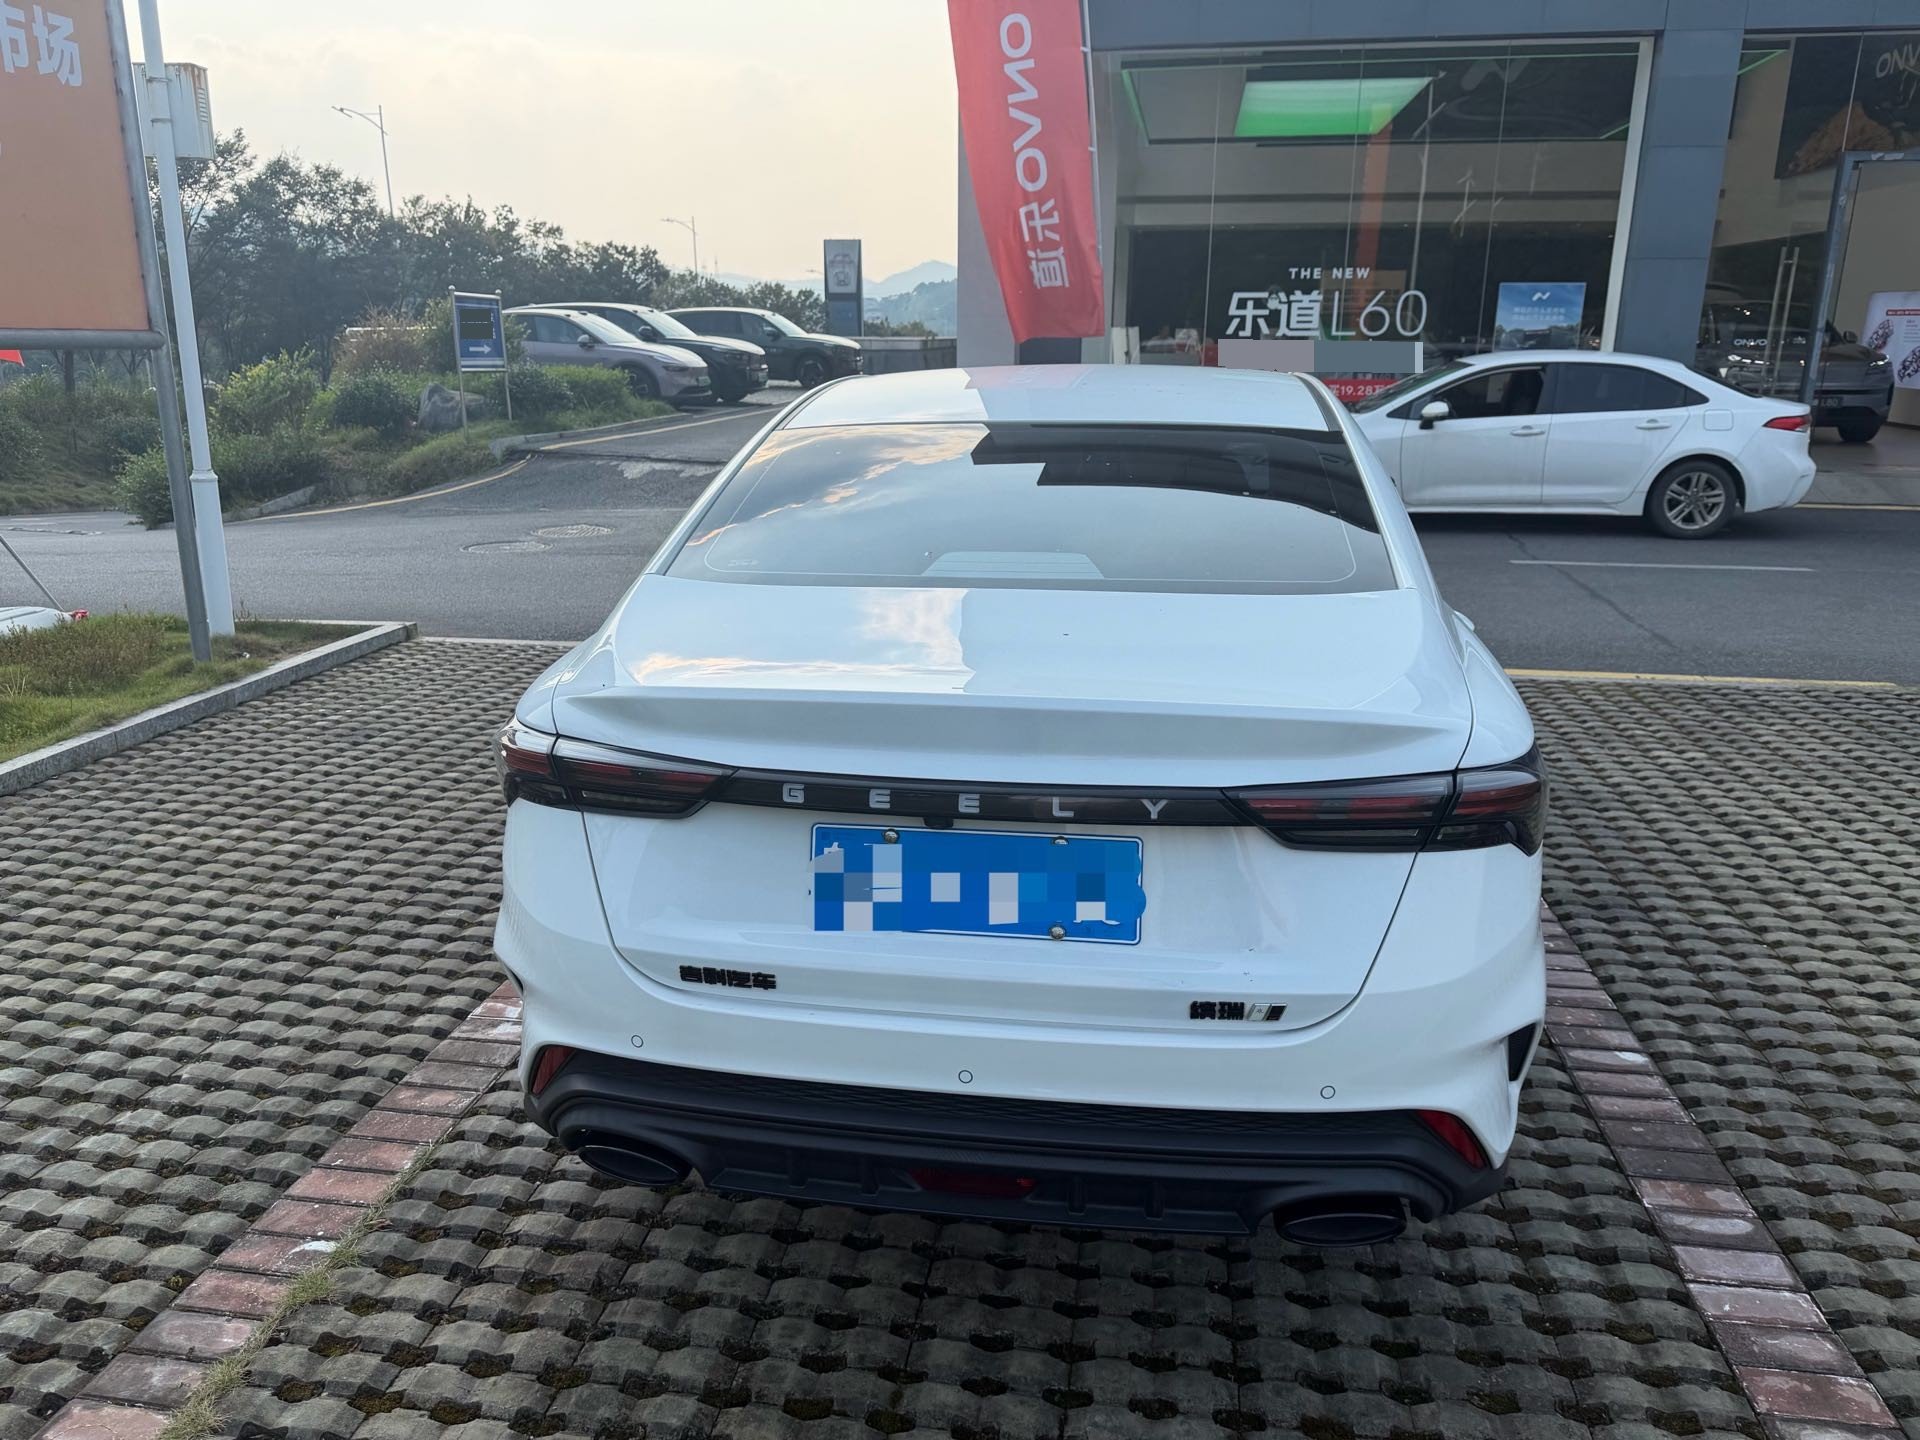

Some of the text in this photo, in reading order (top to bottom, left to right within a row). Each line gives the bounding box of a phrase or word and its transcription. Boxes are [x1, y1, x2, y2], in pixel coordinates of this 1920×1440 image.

[0, 0, 82, 86] 市场
[1289, 267, 1370, 279] THE NEW
[782, 783, 1168, 820] GEELY
[679, 965, 776, 990] 吉利汽车
